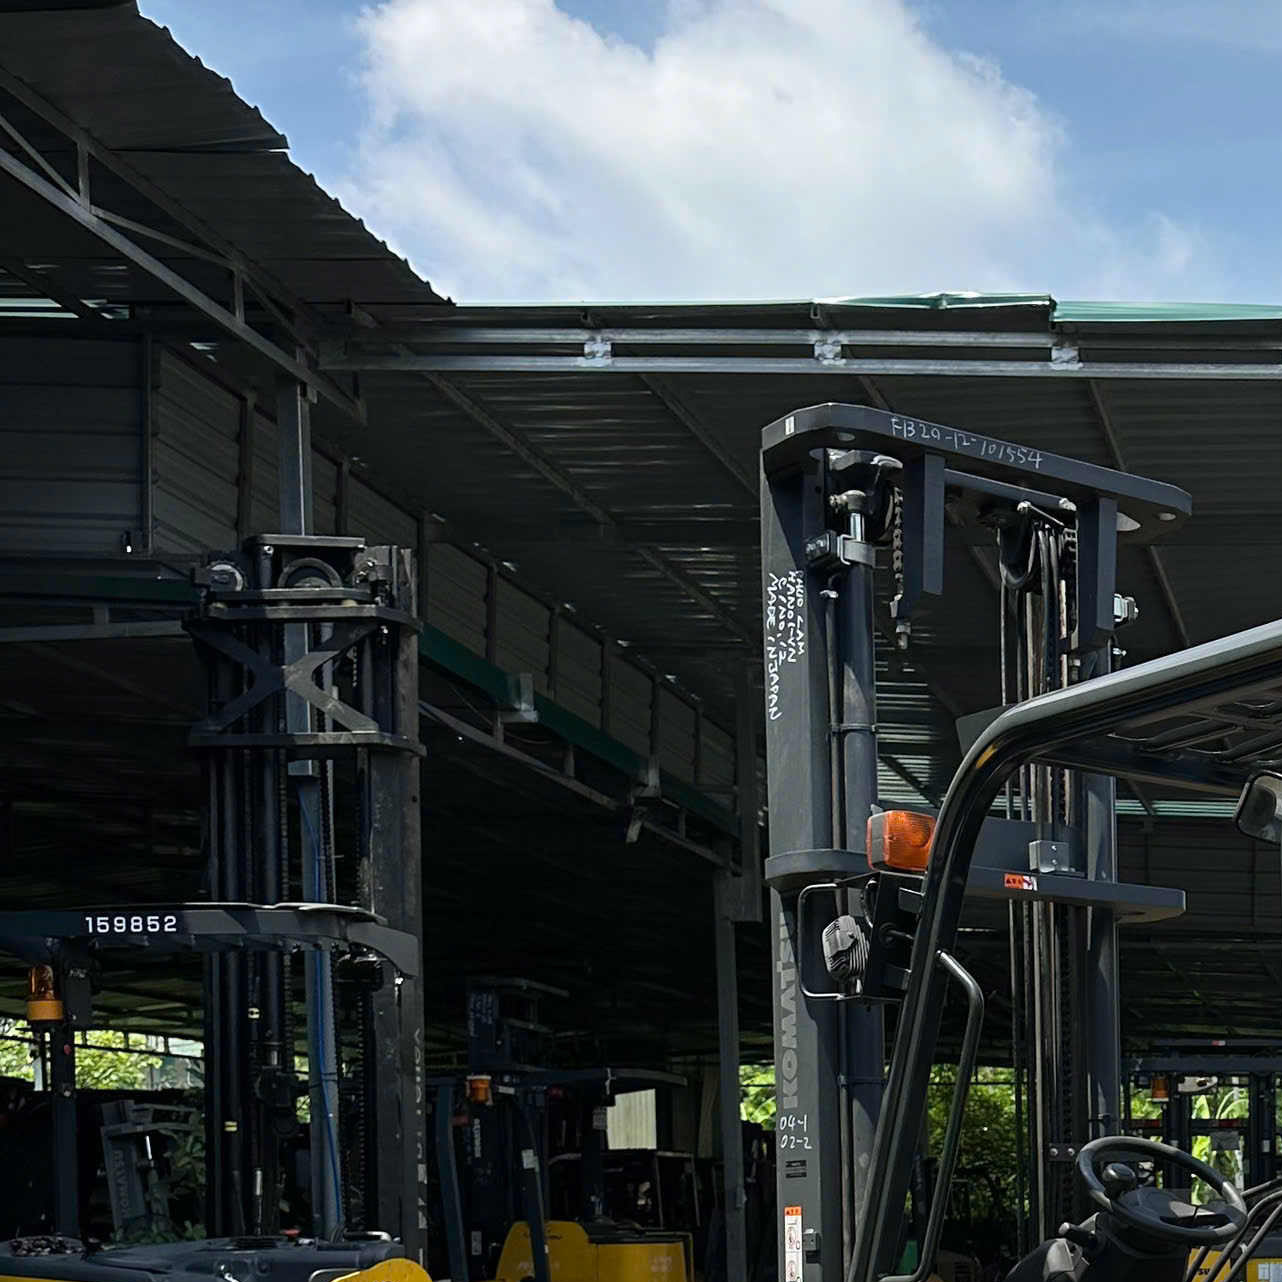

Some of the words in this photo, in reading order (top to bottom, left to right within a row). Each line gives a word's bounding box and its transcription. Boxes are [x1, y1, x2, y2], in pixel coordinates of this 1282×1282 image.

[766, 573, 779, 630] MADE
[767, 660, 783, 720] JAPAN
[85, 916, 177, 933] 159852
